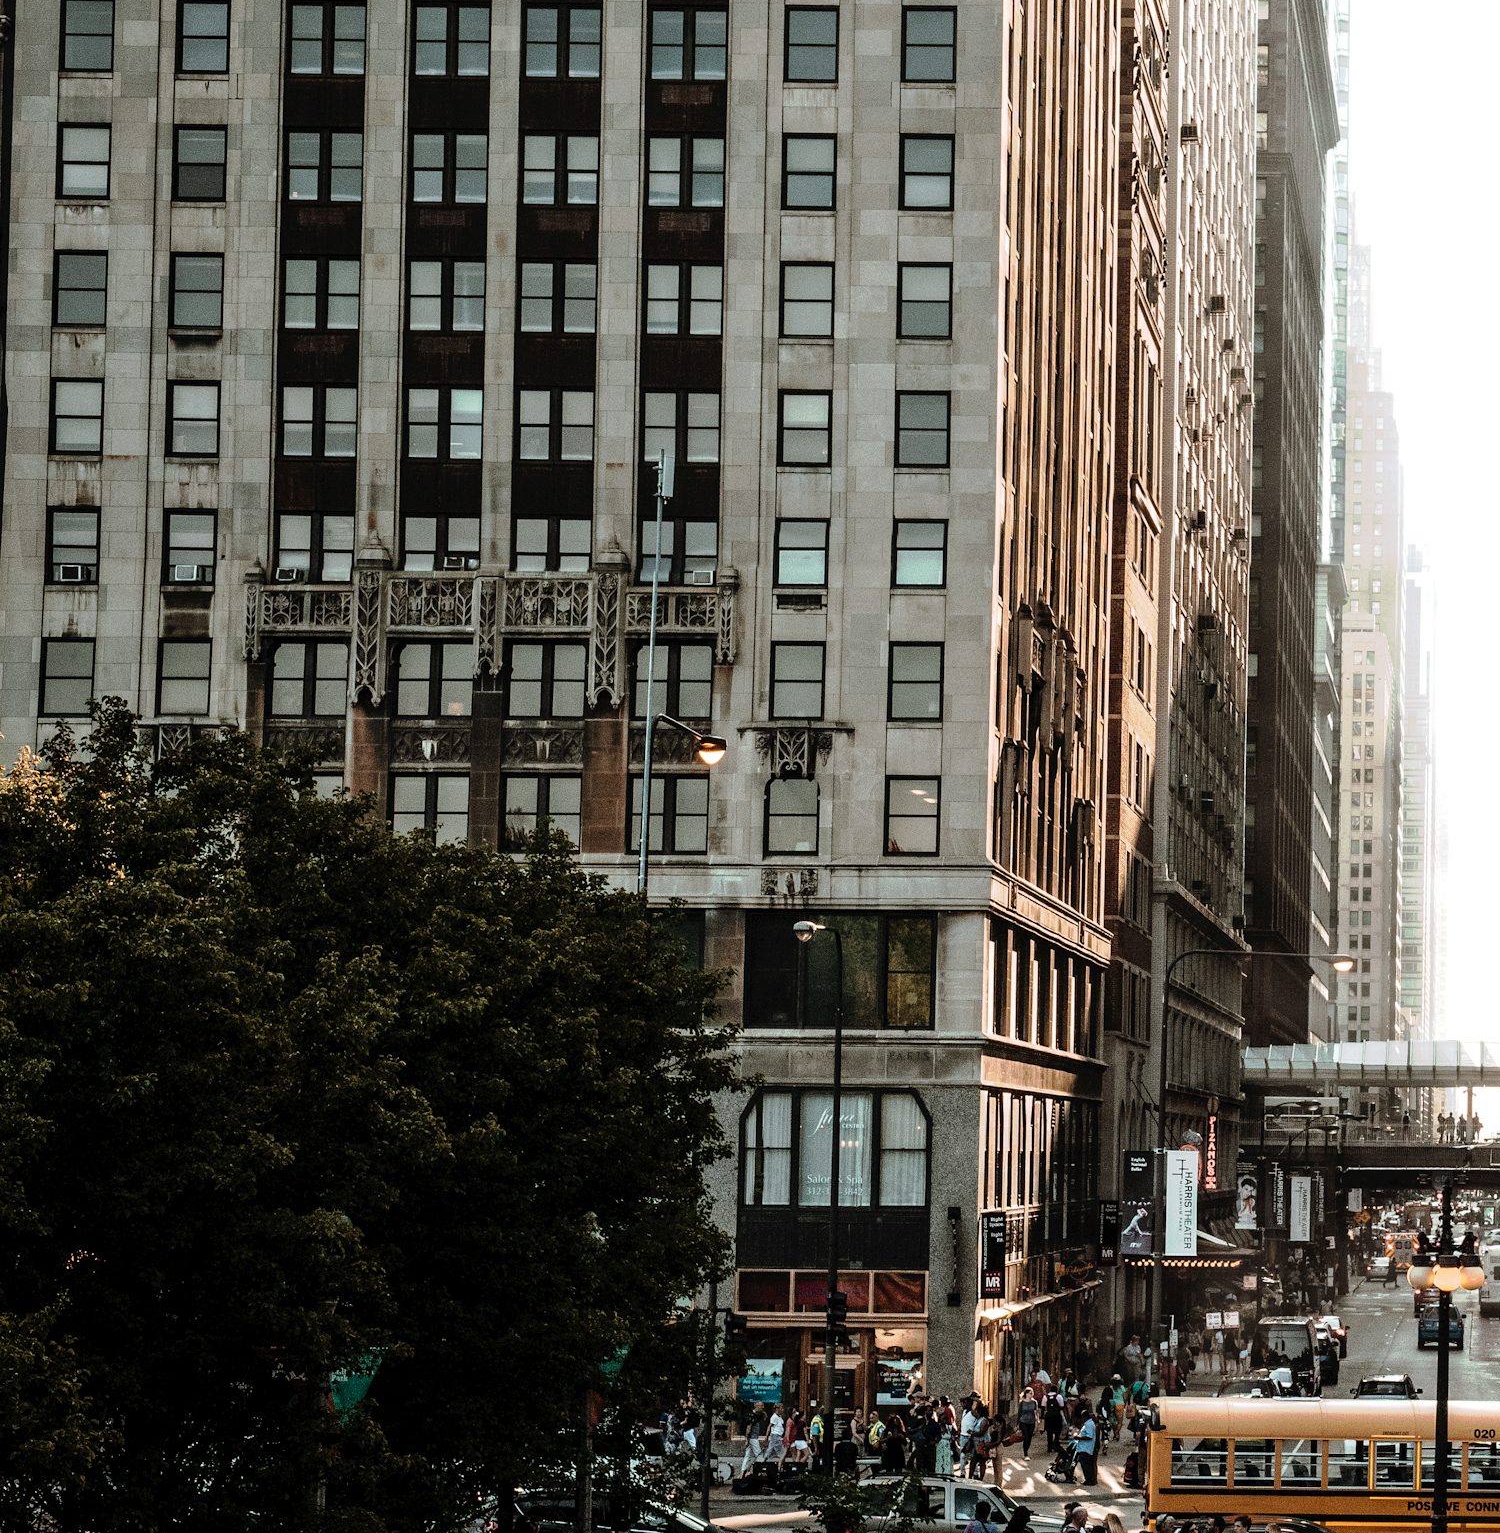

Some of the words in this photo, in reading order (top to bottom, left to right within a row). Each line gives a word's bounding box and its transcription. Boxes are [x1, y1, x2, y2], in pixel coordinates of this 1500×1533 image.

[888, 1050, 930, 1060] PARIS
[846, 1174, 862, 1186] Spa
[807, 1187, 863, 1195] 312-3-3842
[1185, 1172, 1193, 1207] HARRIS
[1184, 1209, 1192, 1249] THEATER
[1101, 1249, 1113, 1257] MR
[985, 1277, 1000, 1287] MR
[1474, 1429, 1496, 1438] 020
[1407, 1502, 1460, 1511] POSIVE
